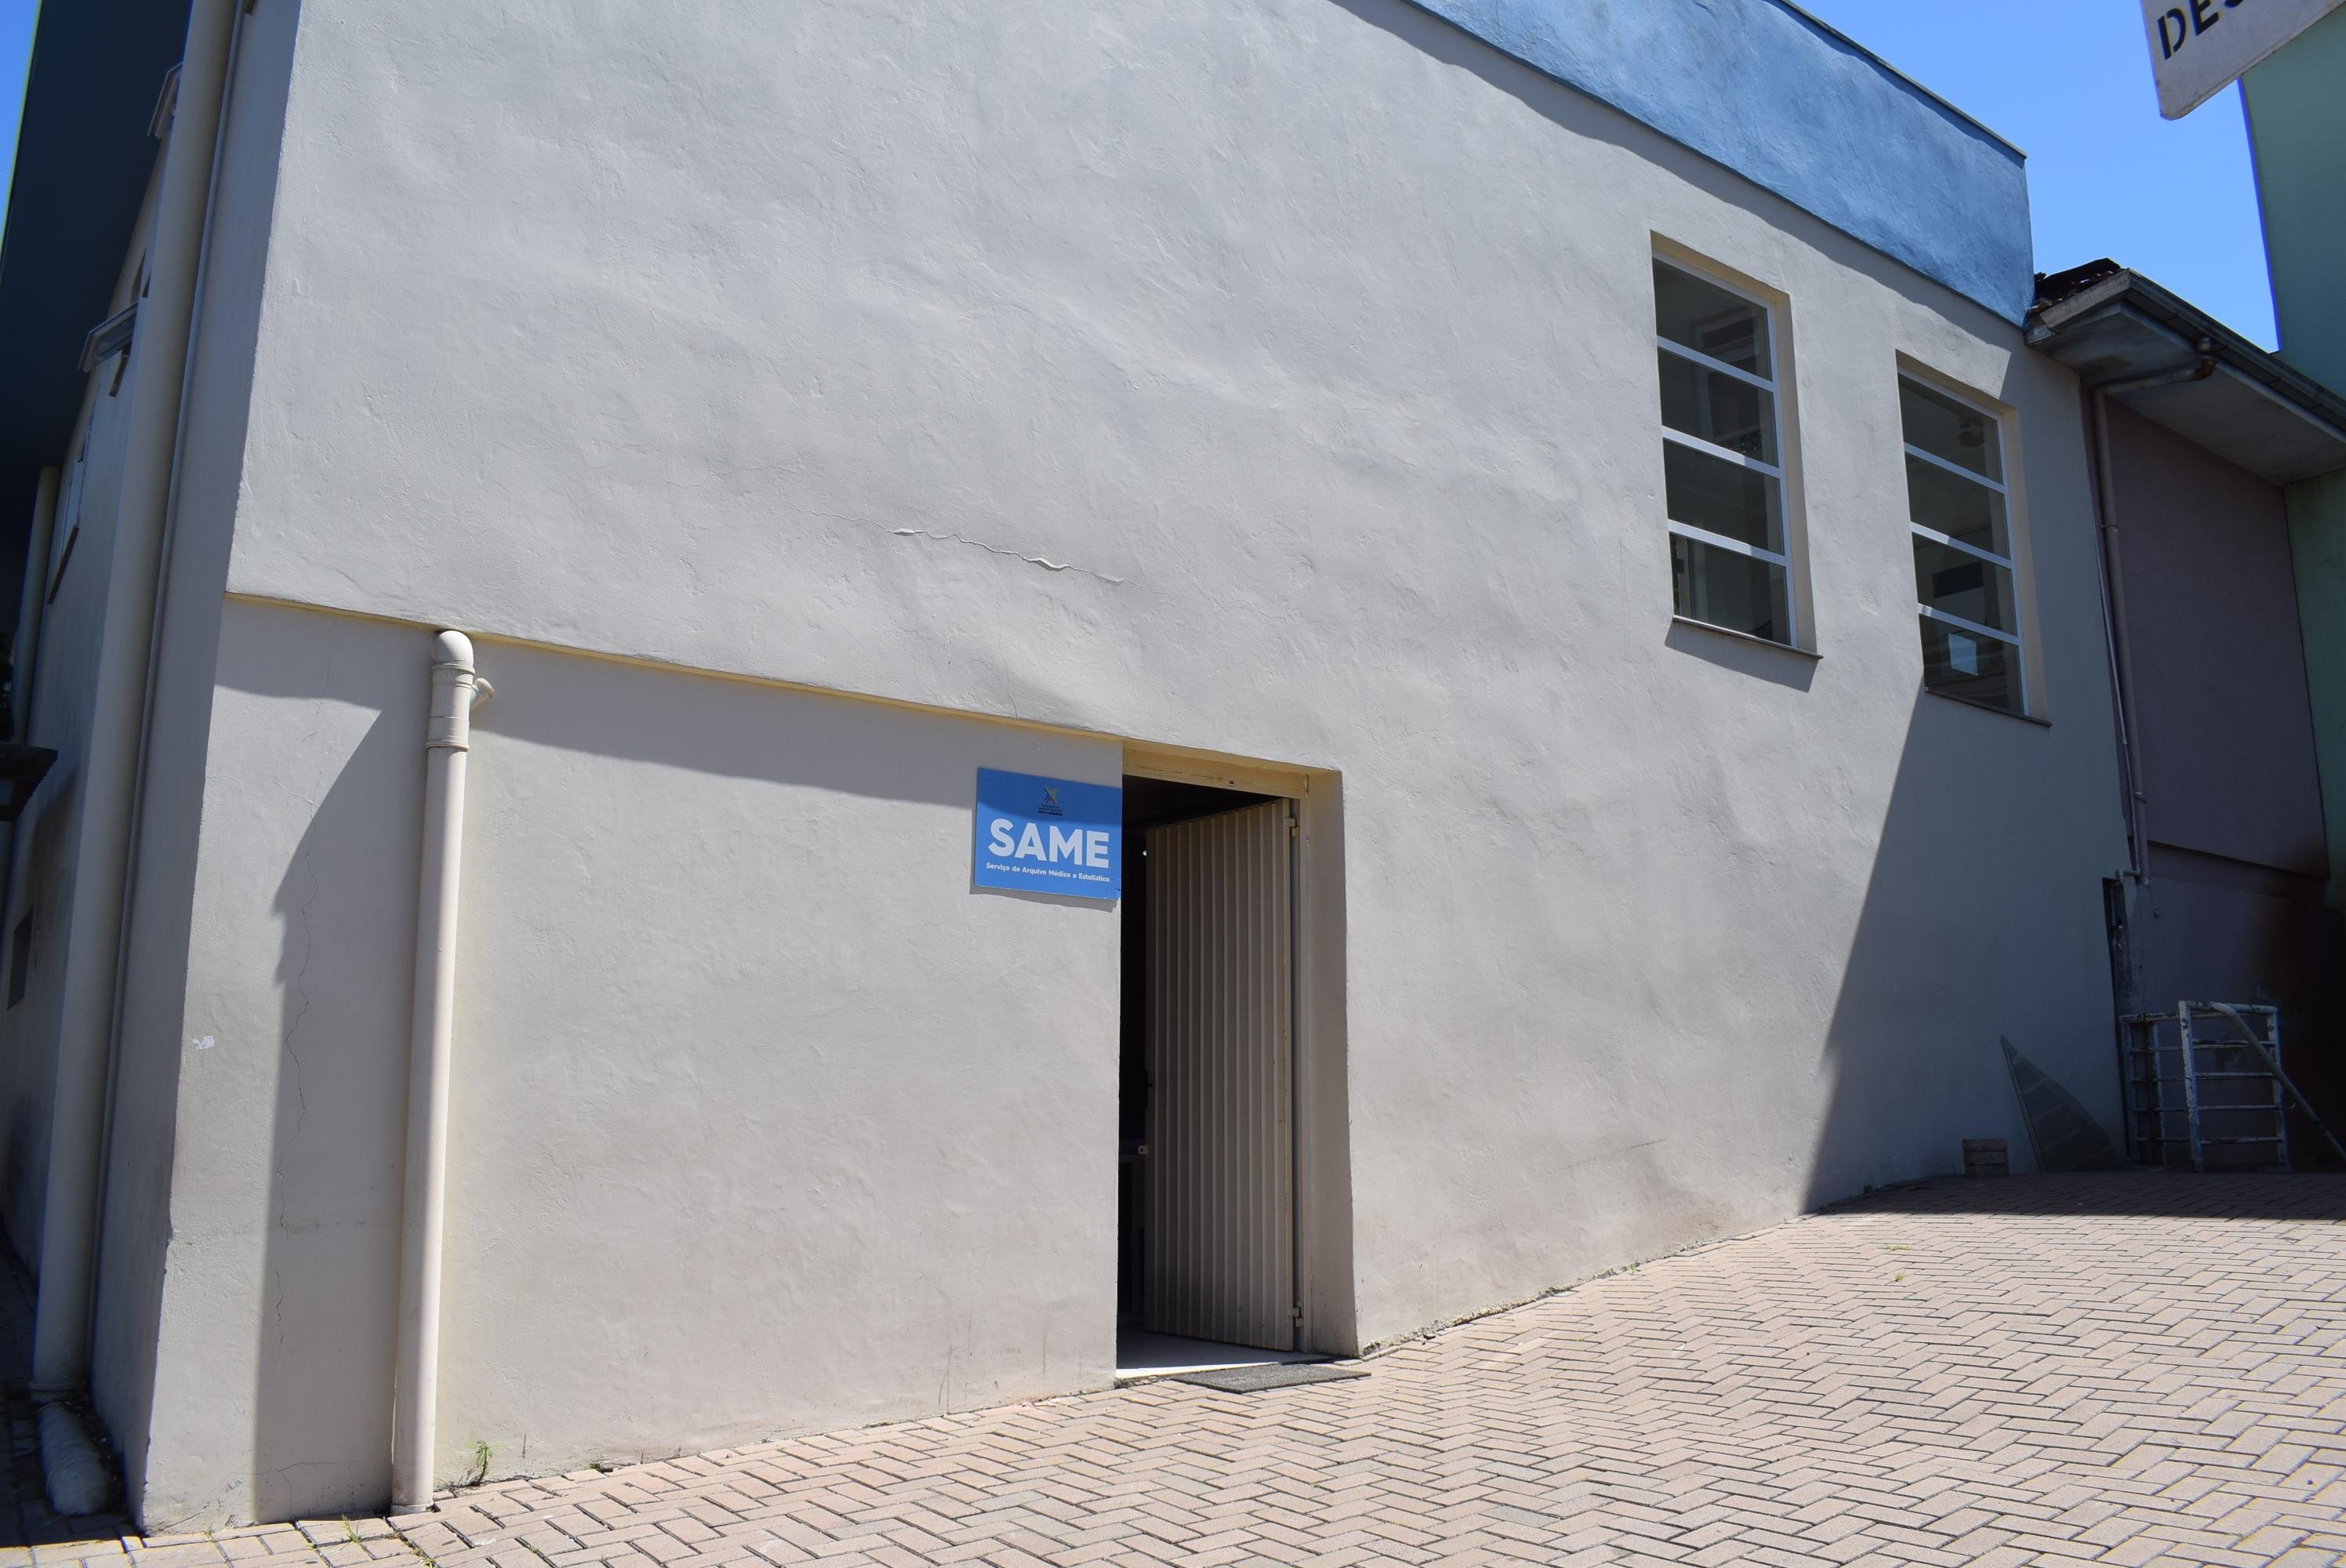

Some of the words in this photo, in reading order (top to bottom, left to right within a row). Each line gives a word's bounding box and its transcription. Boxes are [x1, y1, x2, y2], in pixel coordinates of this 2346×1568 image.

[2157, 0, 2244, 60] DE
[986, 862, 1010, 872] Serviço
[1022, 867, 1047, 876] Arquivo
[988, 818, 1109, 869] SAME
